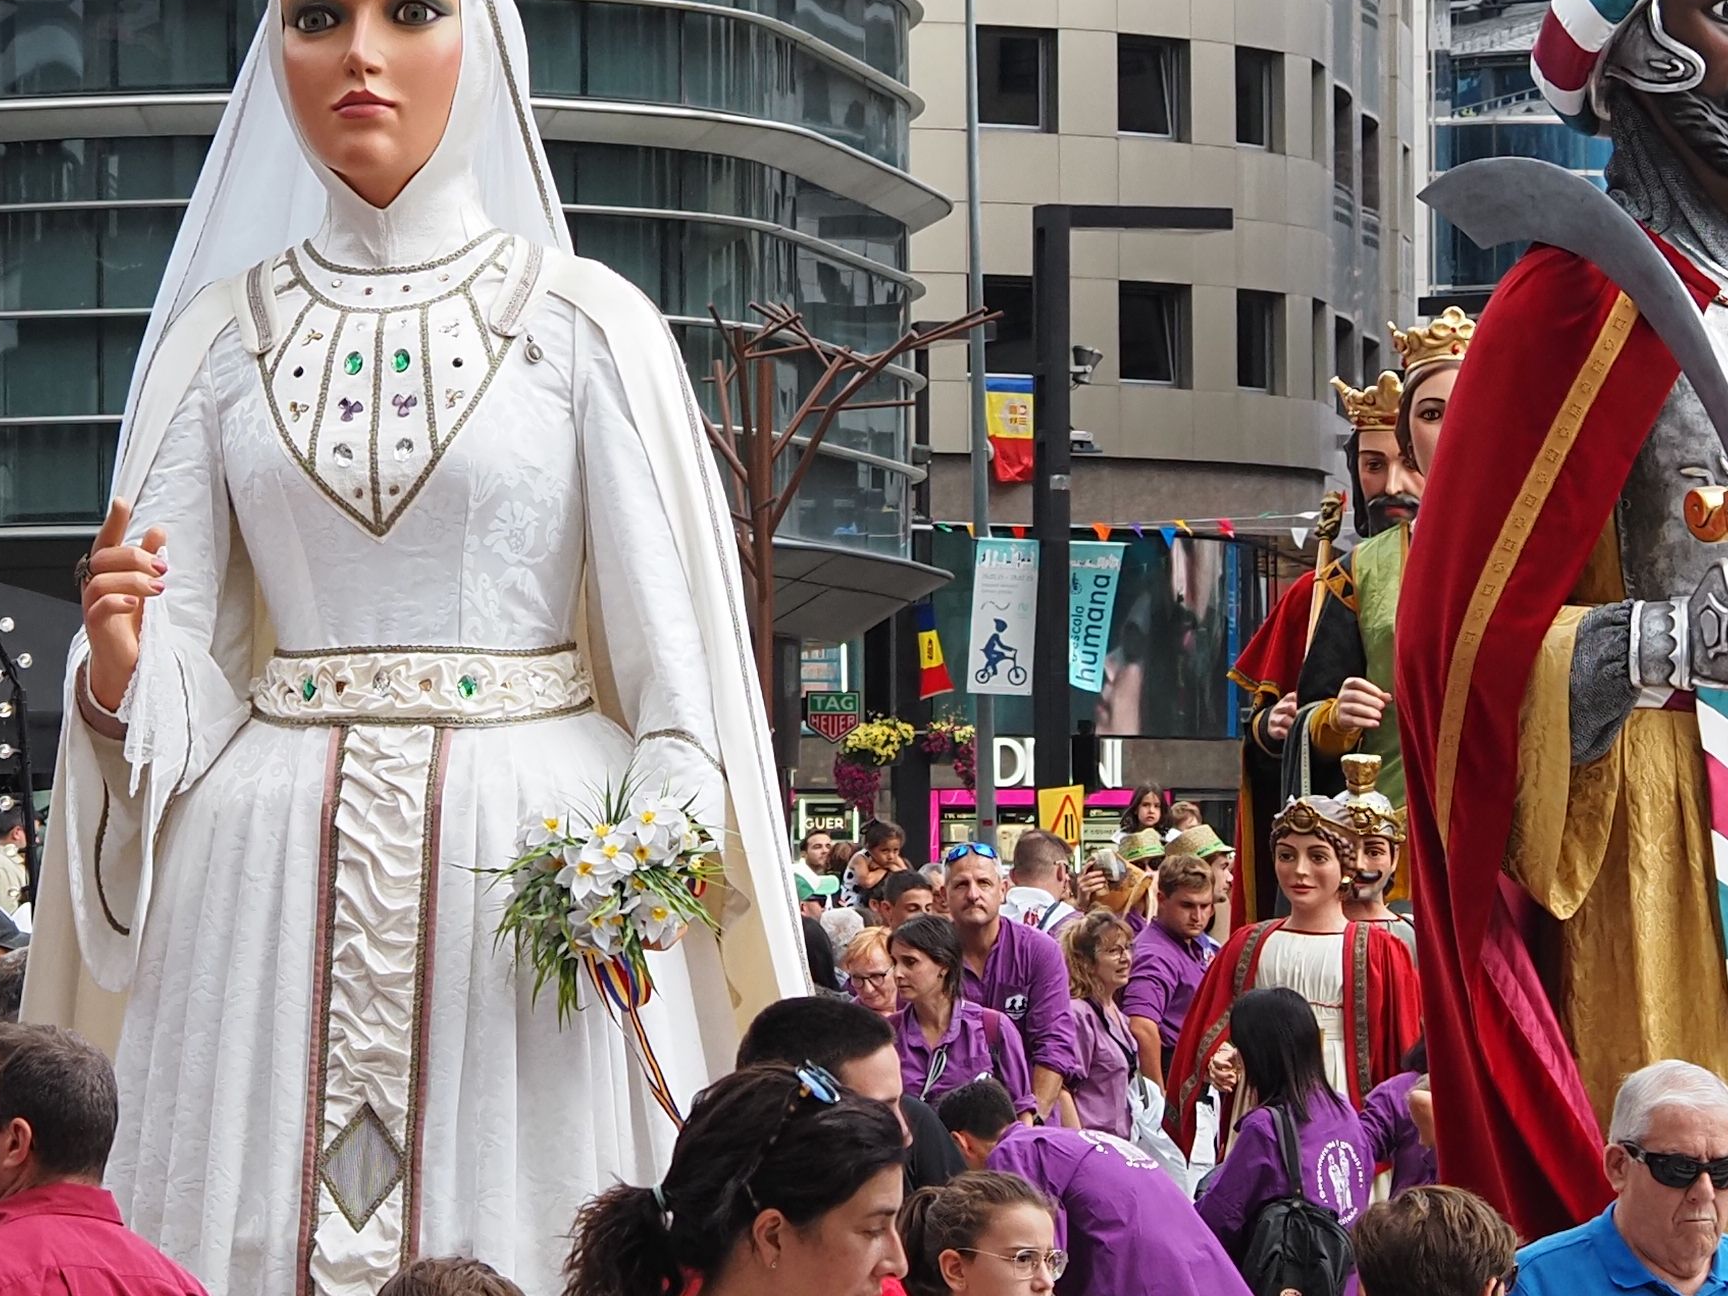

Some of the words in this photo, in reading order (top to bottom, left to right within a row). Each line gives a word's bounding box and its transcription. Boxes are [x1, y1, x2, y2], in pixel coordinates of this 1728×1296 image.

[1076, 573, 1112, 683] humana
[812, 695, 855, 711] TAG
[811, 715, 856, 739] HEUER
